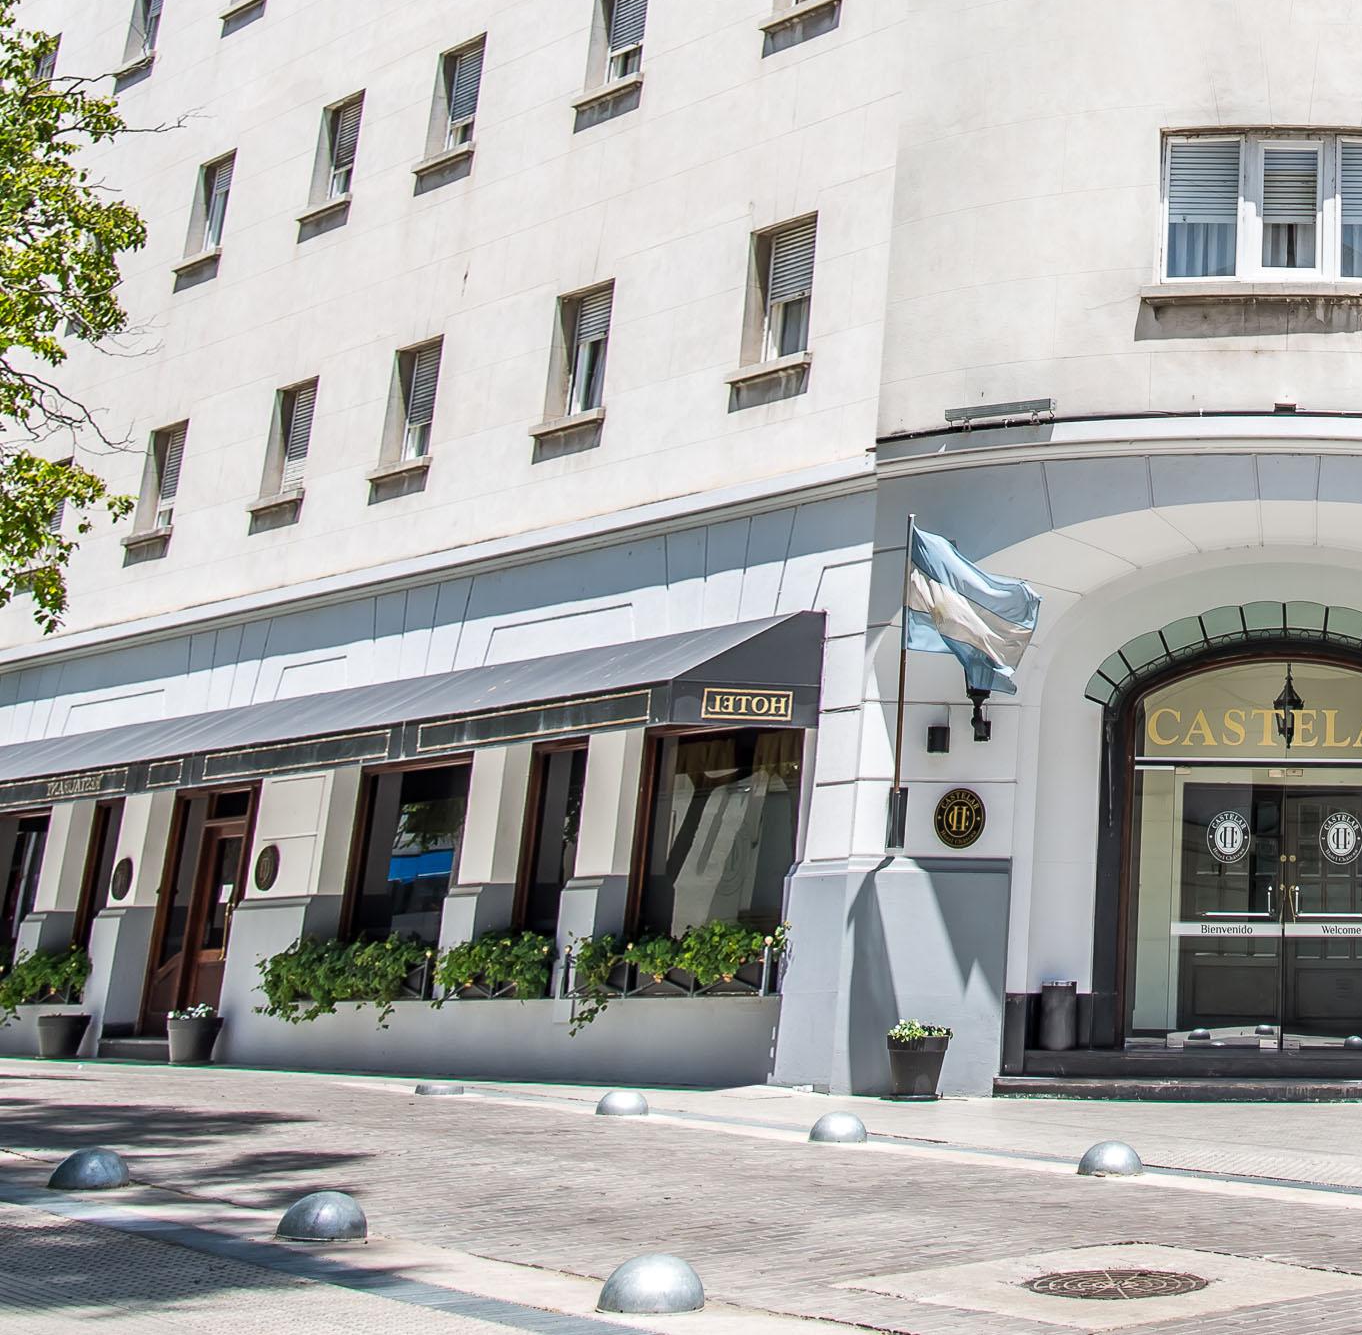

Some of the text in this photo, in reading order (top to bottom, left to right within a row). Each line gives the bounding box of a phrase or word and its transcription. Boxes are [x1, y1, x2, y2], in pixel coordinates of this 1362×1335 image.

[940, 792, 980, 809] CASTELAR
[1211, 813, 1247, 829] CASTELAR
[1323, 814, 1359, 831] CASTELAR
[1200, 924, 1253, 935] Bienvenido
[1321, 925, 1362, 935] Welcome
